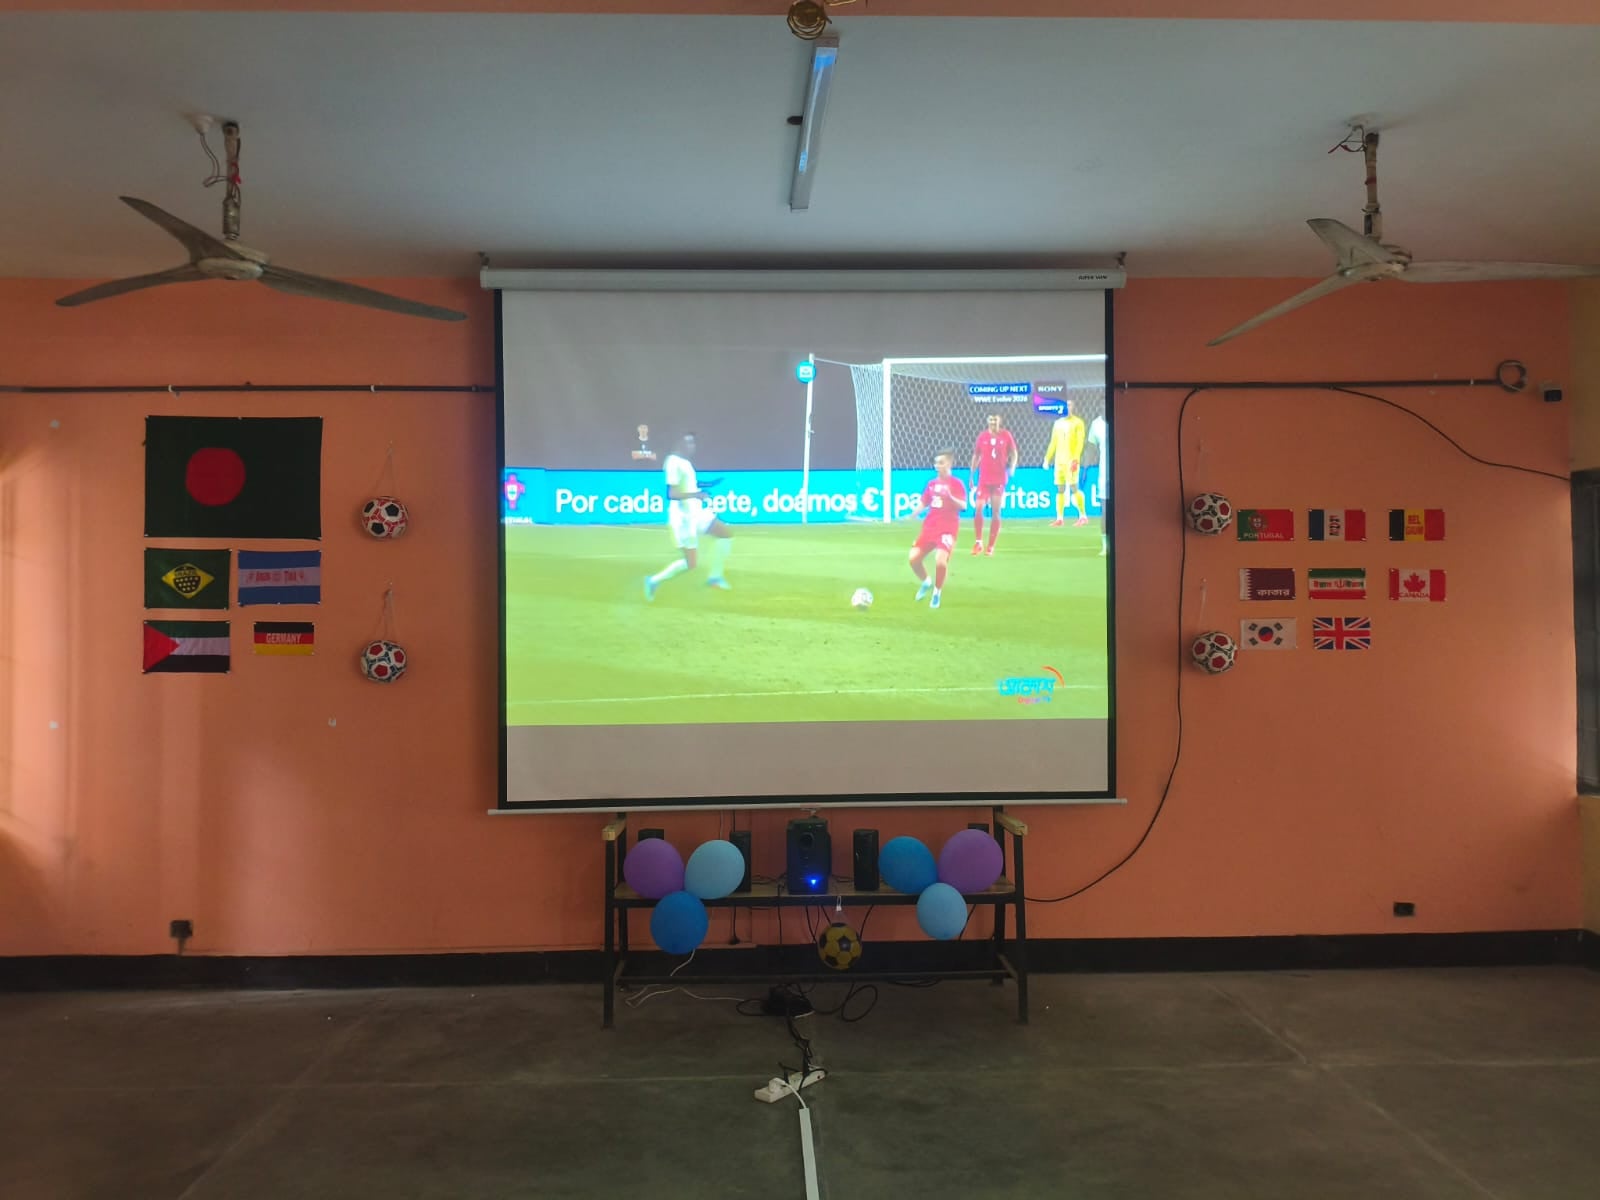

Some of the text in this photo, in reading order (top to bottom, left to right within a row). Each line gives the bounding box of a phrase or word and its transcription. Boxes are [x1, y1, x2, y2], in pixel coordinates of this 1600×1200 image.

[999, 385, 1010, 393] UP
[556, 488, 599, 513] Por
[603, 488, 664, 513] cada
[1256, 588, 1290, 598] কাতার
[266, 632, 302, 644] GERMANY
